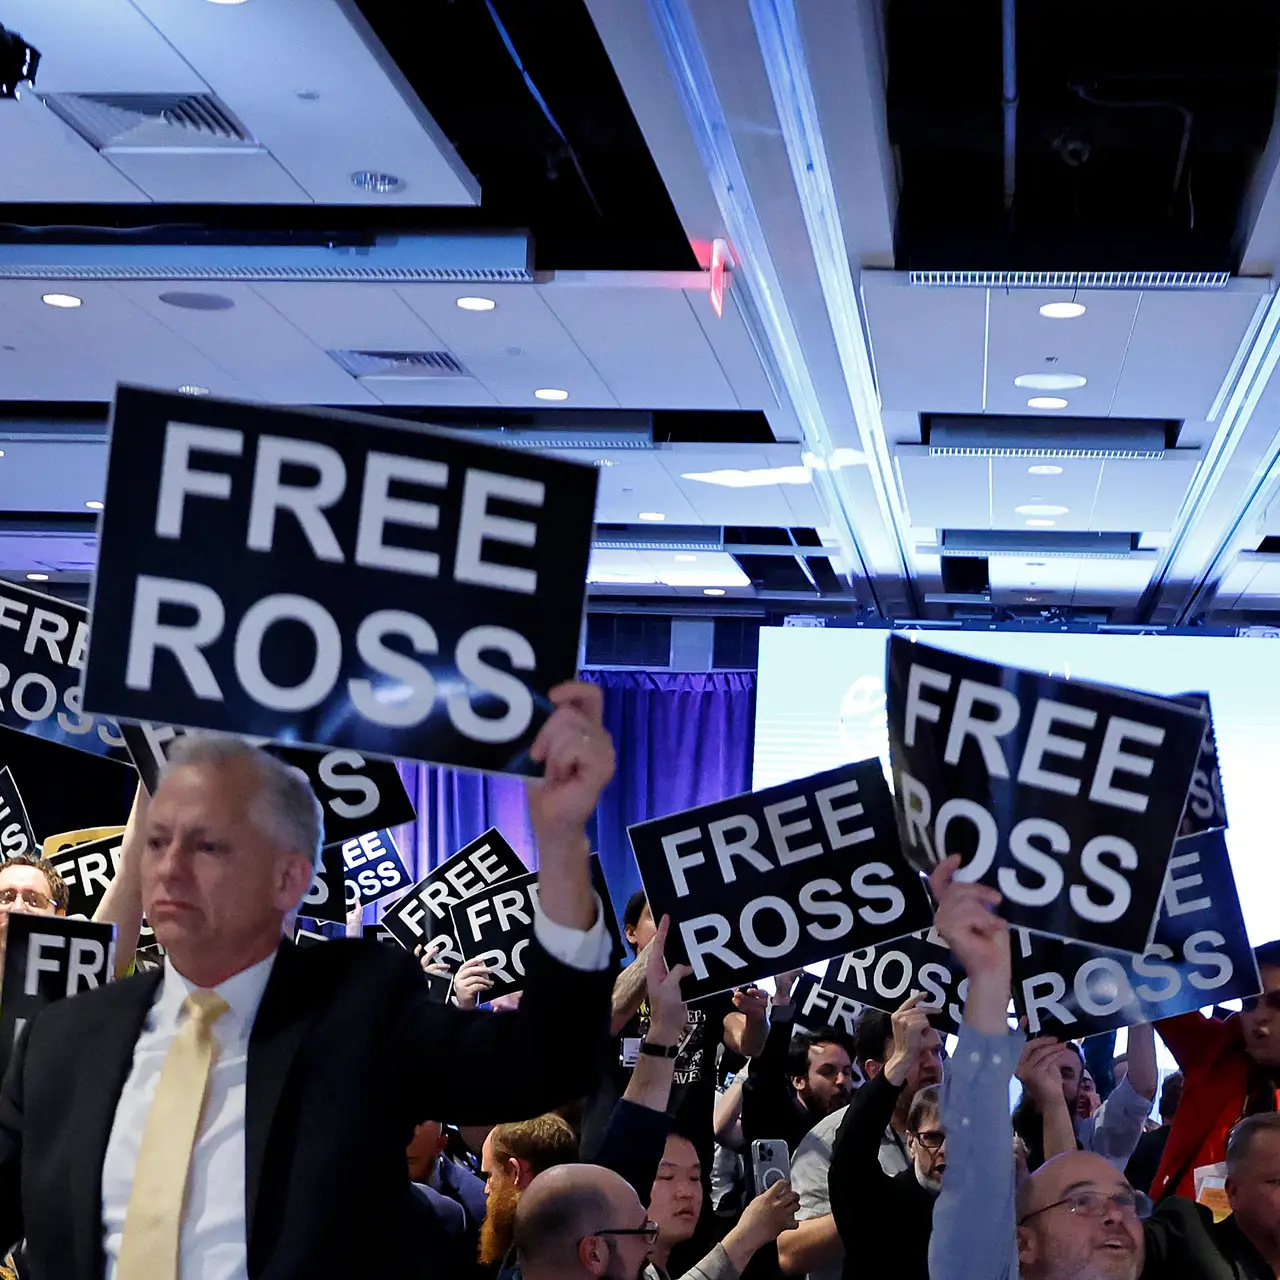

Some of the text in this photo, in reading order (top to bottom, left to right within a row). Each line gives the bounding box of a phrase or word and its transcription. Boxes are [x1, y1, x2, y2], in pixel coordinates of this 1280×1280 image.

[154, 420, 546, 594] FREE
[125, 574, 537, 744] ROSS
[903, 663, 1166, 814] FREE
[341, 831, 387, 873] EE
[344, 860, 401, 906] OSS
[398, 843, 509, 938] FREE
[661, 779, 875, 898] FREE
[901, 771, 1139, 924] ROSS
[24, 932, 115, 998] FR
[466, 882, 539, 943] FR
[678, 861, 907, 982] ROSS
[1022, 929, 1234, 1033] ROSS
